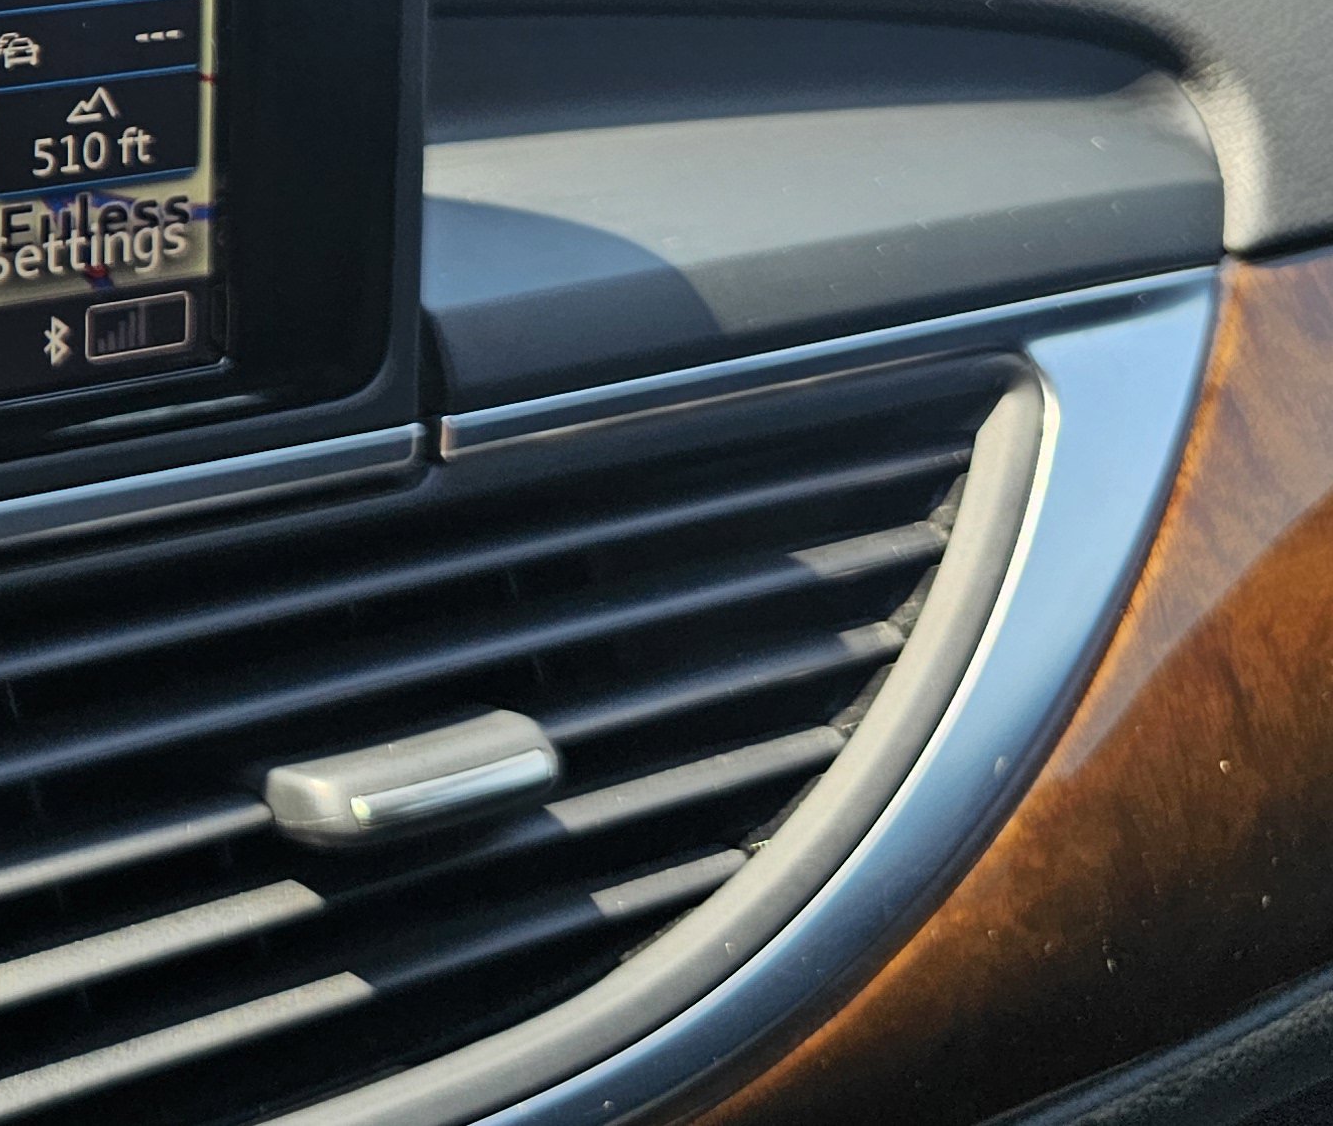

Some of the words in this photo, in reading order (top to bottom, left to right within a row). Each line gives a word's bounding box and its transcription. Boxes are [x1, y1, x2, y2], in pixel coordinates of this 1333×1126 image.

[31, 136, 107, 176] 510
[118, 127, 153, 165] ft
[0, 193, 190, 248] Euless
